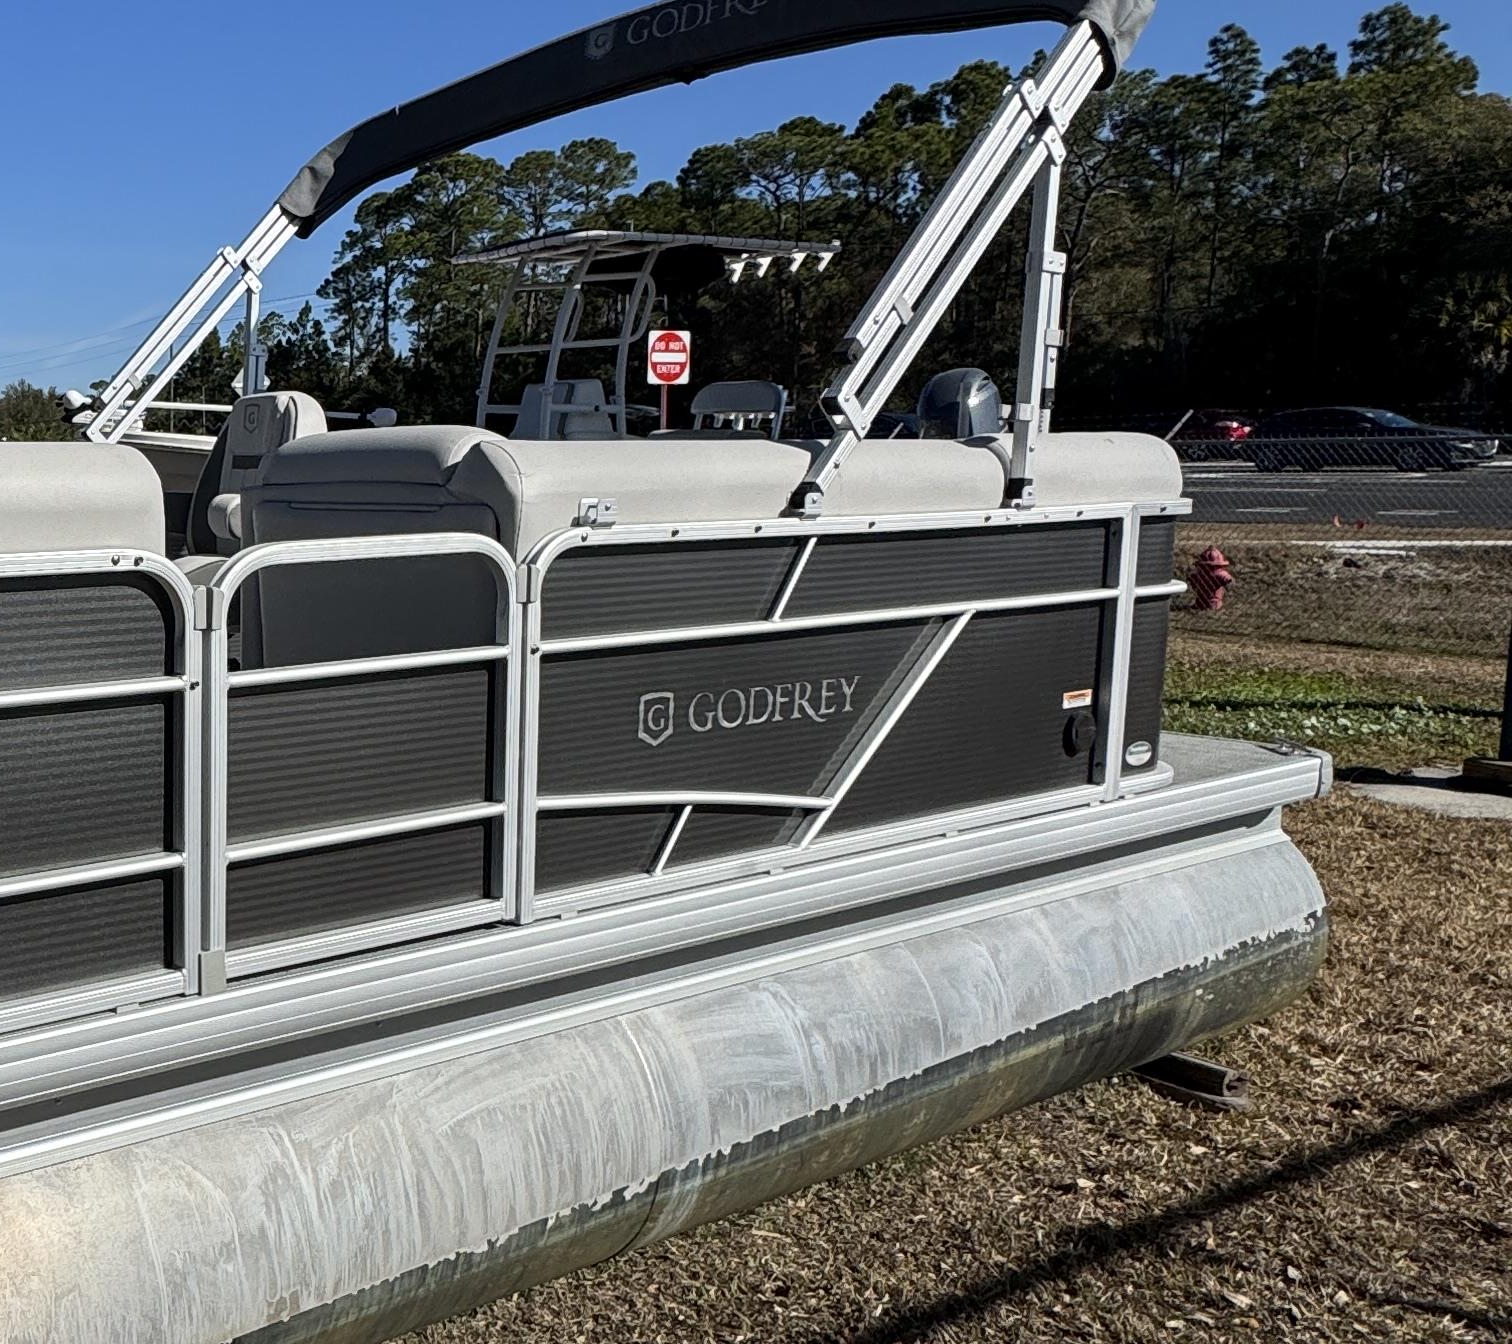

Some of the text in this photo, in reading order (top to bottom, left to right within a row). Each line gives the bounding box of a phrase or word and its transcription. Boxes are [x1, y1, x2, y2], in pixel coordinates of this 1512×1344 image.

[654, 340, 684, 351] DO NOT
[656, 364, 681, 374] ENTER
[688, 675, 862, 733] GODFREY
